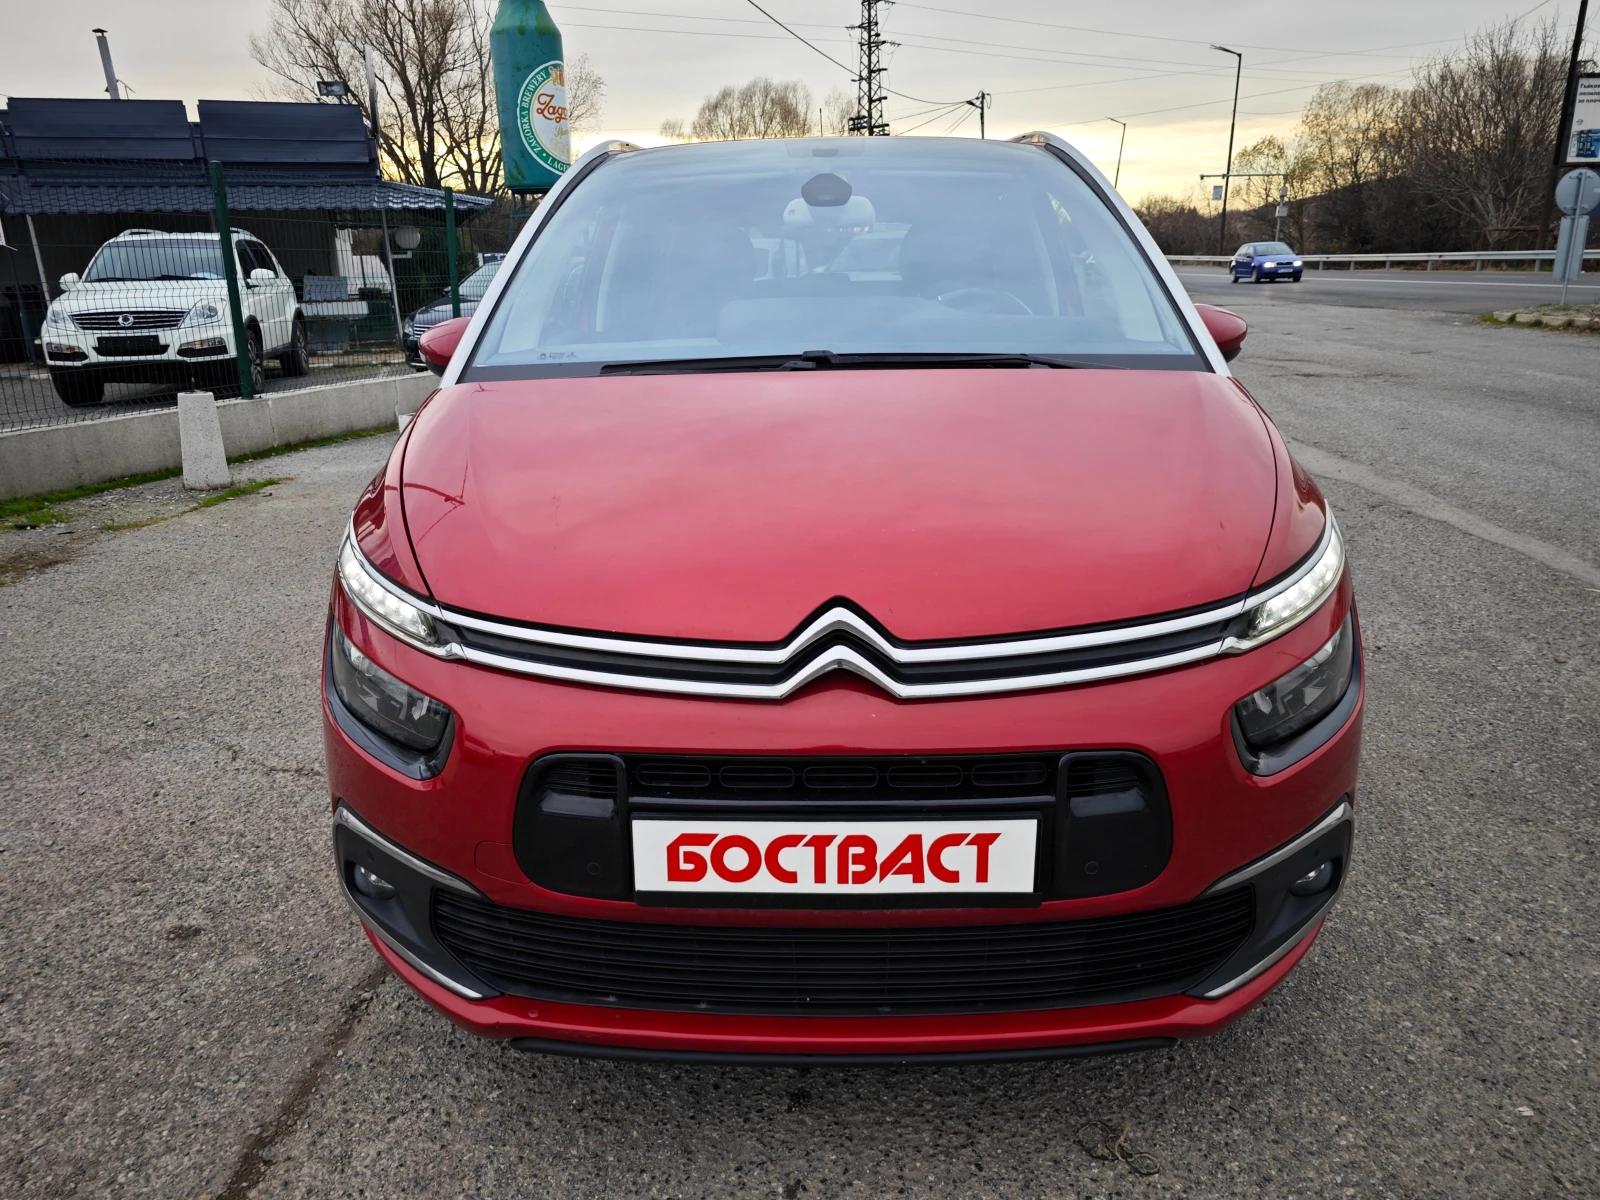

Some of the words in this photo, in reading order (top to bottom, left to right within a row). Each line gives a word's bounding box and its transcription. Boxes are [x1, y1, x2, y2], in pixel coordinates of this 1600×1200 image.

[521, 71, 547, 109] BREWERY
[521, 110, 541, 153] ZAGORKA
[547, 157, 569, 172] LAGE
[667, 833, 1002, 884] БОСТВАСТ
